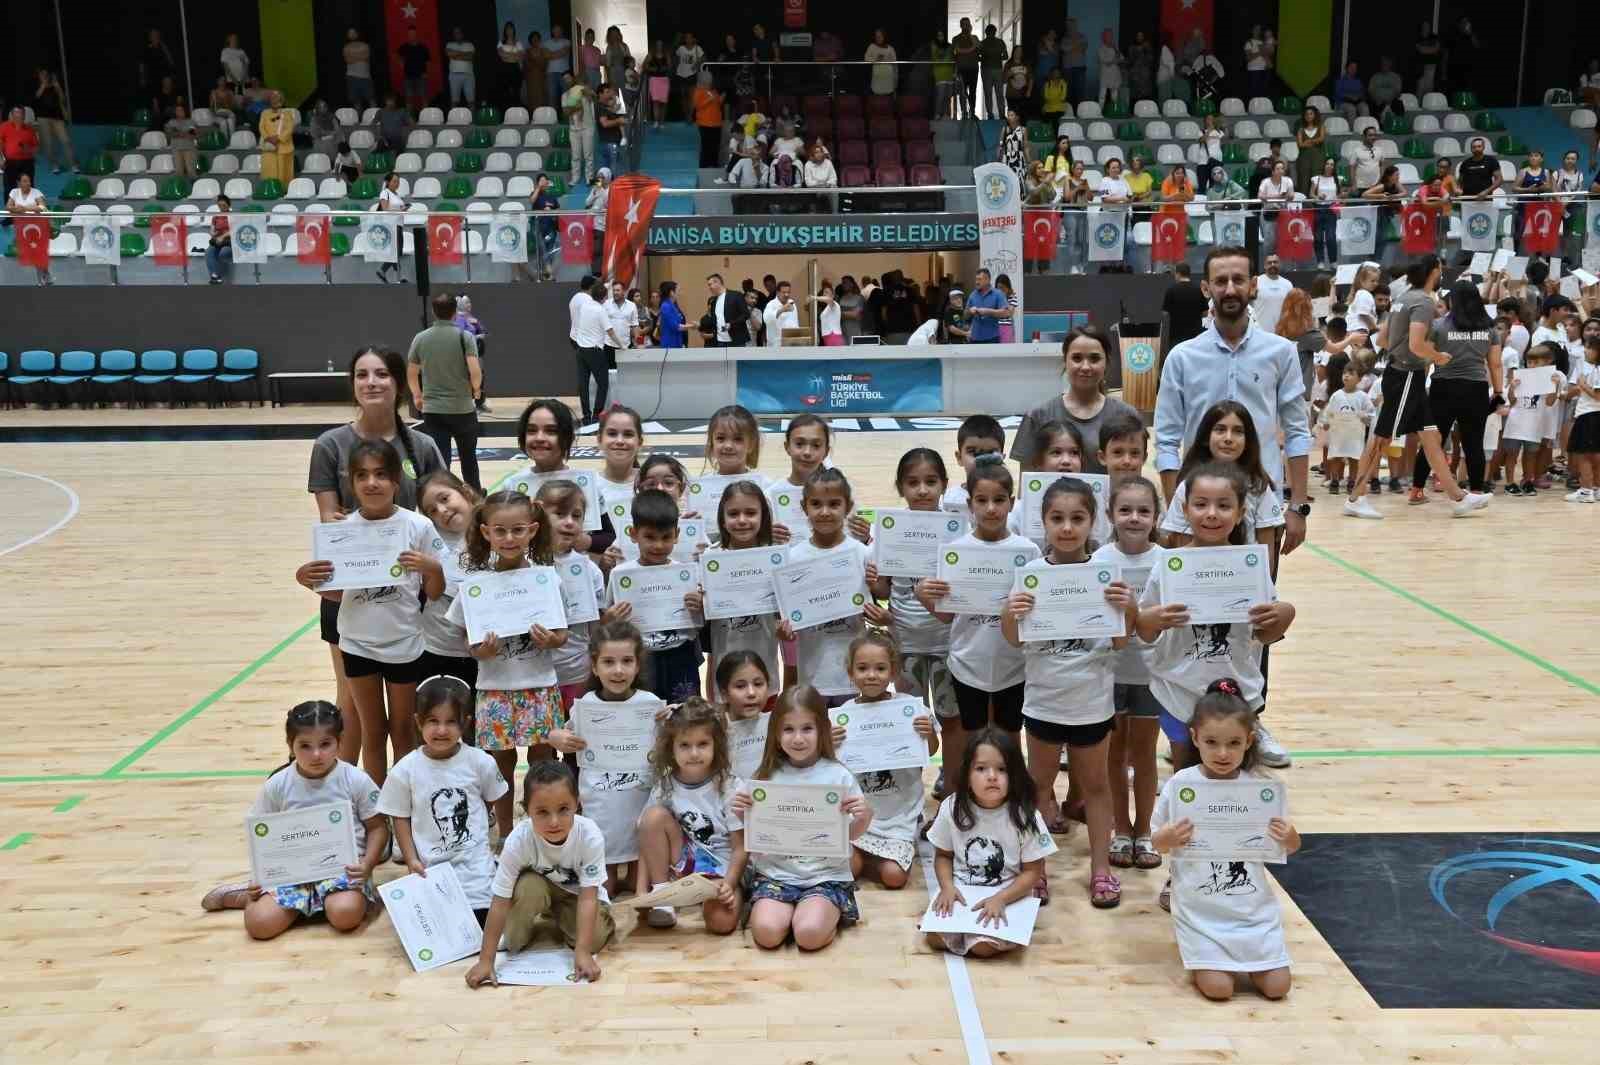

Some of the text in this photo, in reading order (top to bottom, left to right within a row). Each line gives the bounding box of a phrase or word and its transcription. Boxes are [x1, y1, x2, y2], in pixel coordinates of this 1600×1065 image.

[719, 222, 864, 247] BÜYÜKŞEHİR
[830, 382, 869, 392] TÜRKİYE
[830, 391, 884, 400] BASKETBOL
